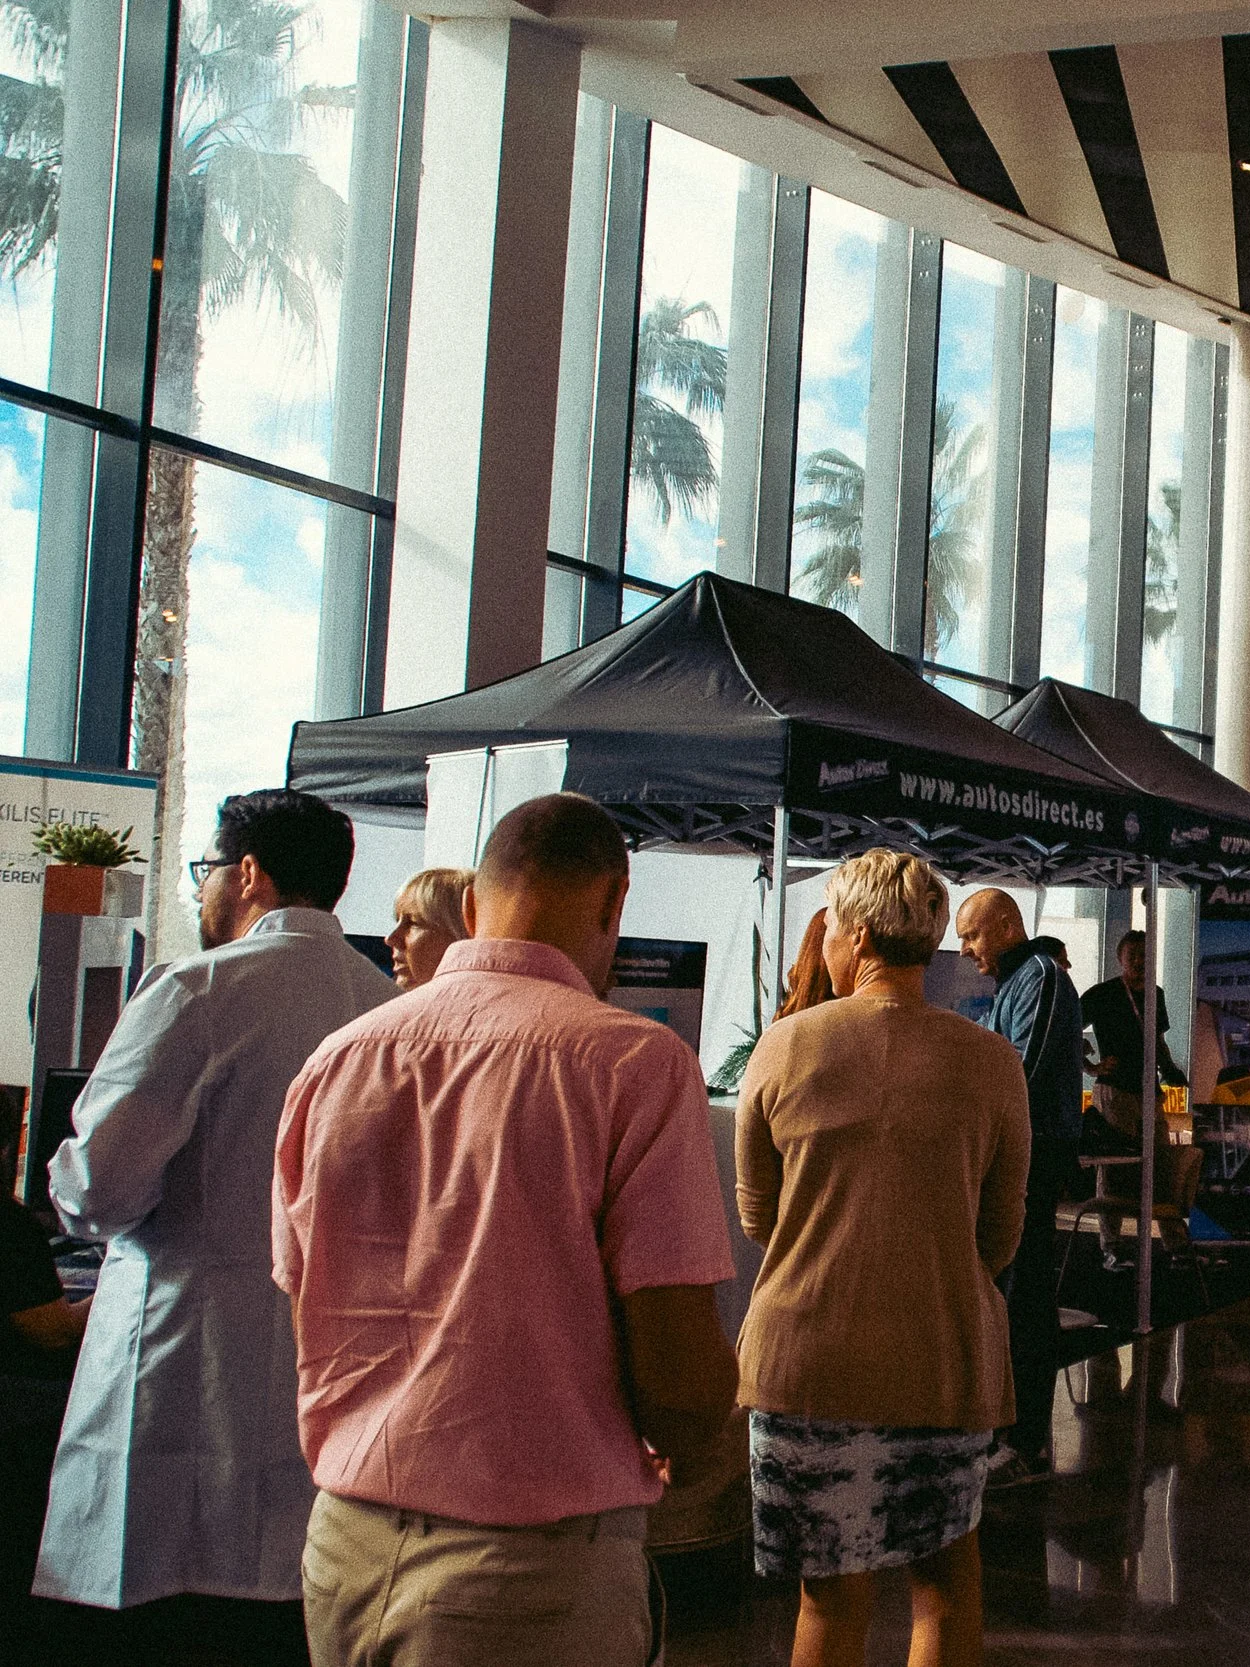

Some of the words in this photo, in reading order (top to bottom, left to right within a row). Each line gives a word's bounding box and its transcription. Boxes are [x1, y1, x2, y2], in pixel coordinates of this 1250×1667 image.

[899, 771, 1105, 832] www.autosdirect.es
[48, 808, 101, 826] ELITE
[0, 869, 45, 884] EREN
